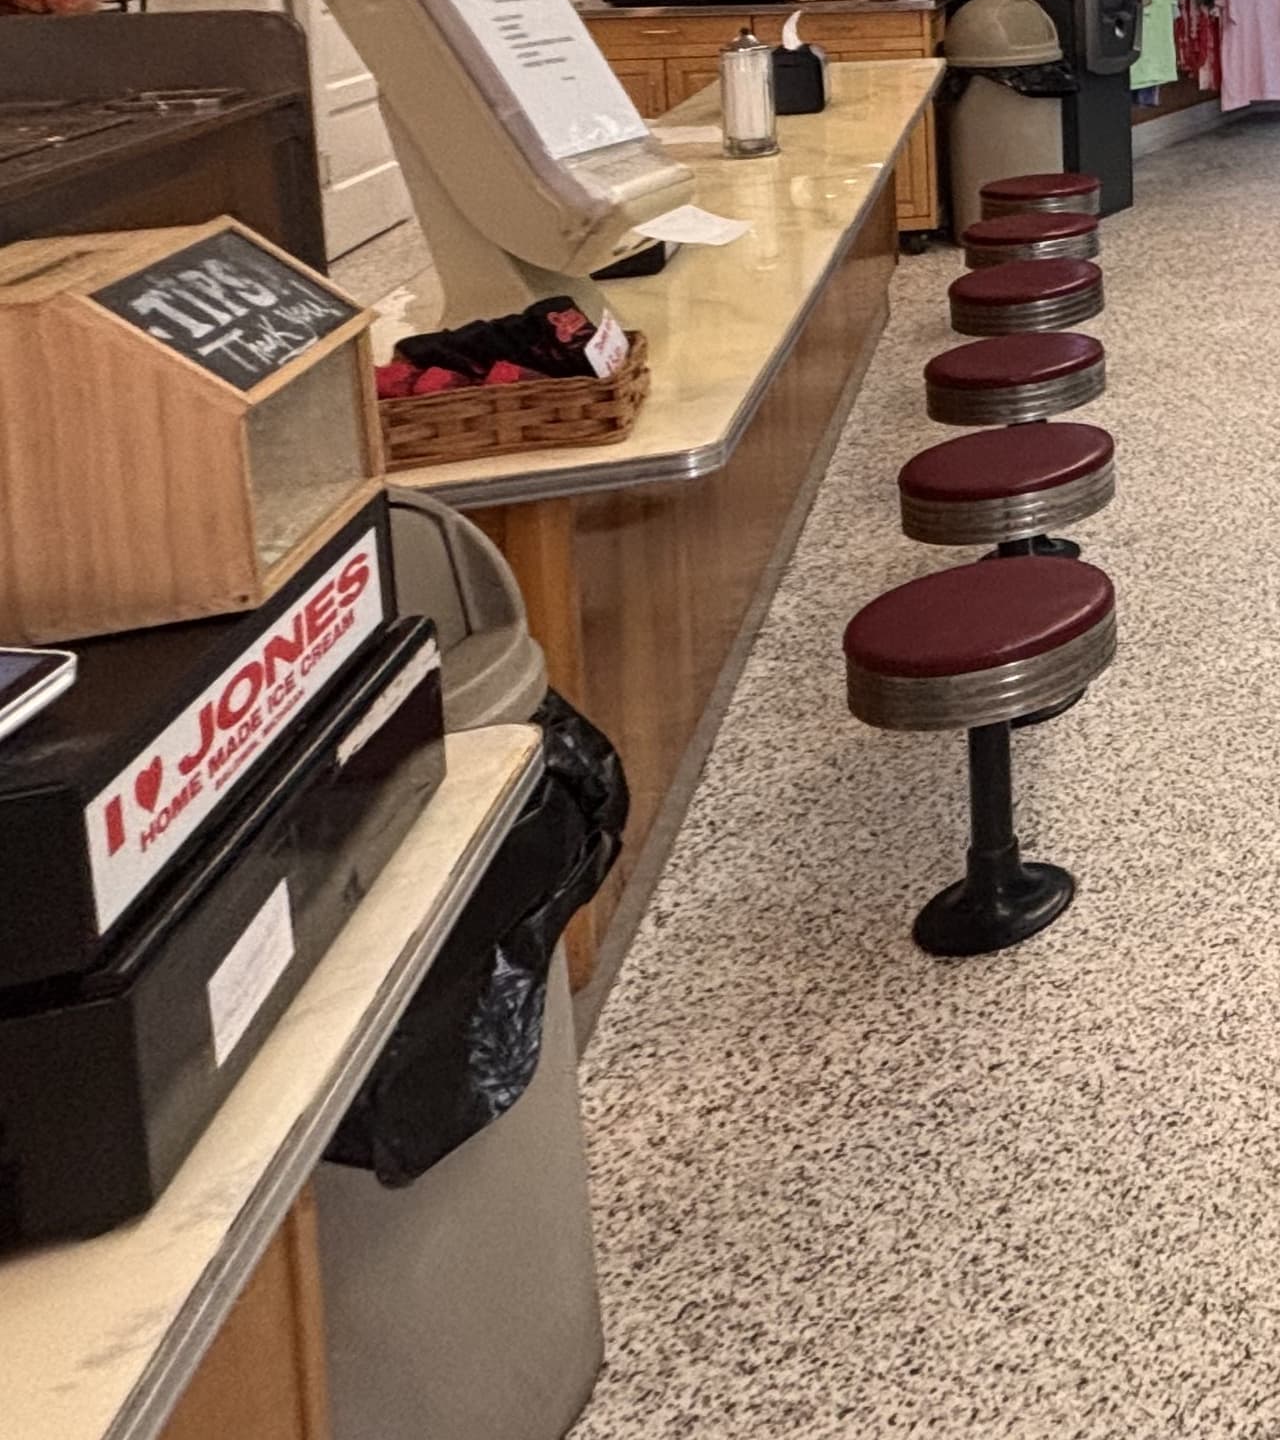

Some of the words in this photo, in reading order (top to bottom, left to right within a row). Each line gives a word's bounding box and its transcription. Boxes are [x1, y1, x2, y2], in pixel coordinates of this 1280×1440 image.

[130, 258, 280, 339] TIPS
[105, 789, 126, 858] I
[178, 552, 370, 777] JONES
[140, 768, 203, 853] HOME
[208, 705, 263, 779] MADE
[267, 671, 297, 715] ICE
[300, 607, 356, 677] CREAM
